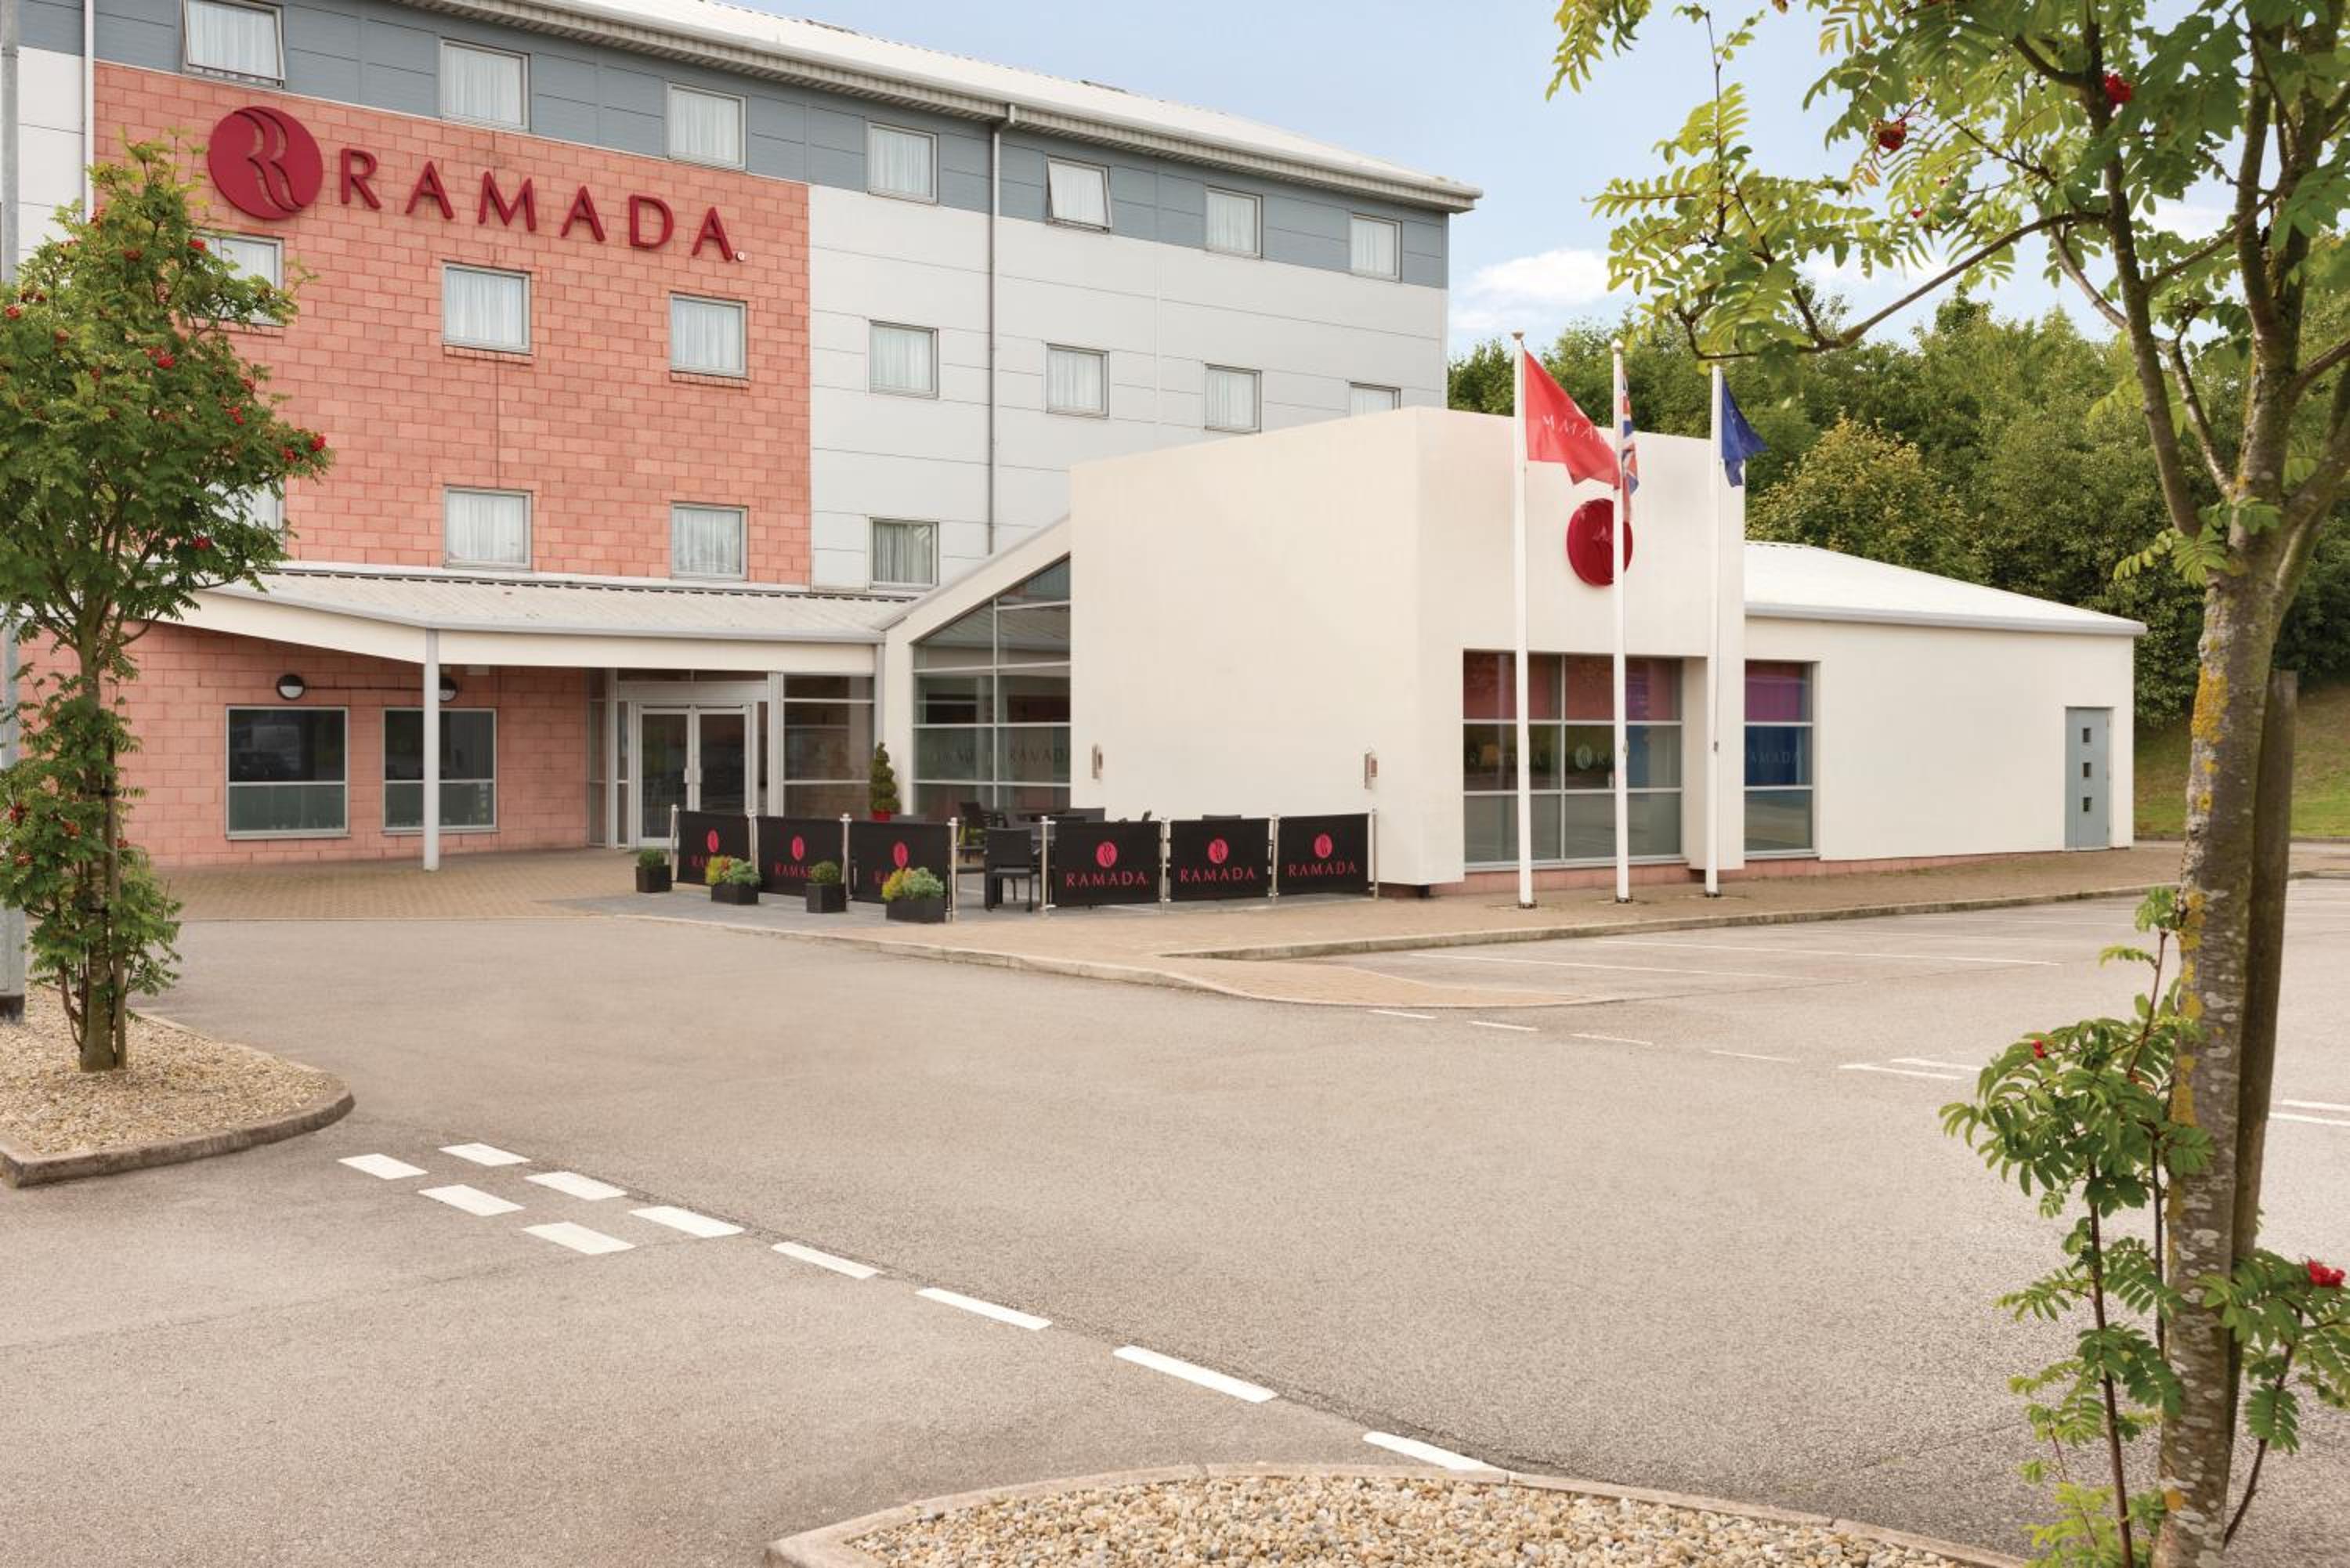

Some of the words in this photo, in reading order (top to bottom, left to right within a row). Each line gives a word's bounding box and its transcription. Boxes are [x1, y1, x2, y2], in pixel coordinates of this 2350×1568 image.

[339, 148, 734, 262] RAMADA
[1179, 866, 1256, 884] RAMADA
[1289, 859, 1358, 878] RAMADA
[1065, 870, 1147, 889] RAMADA
